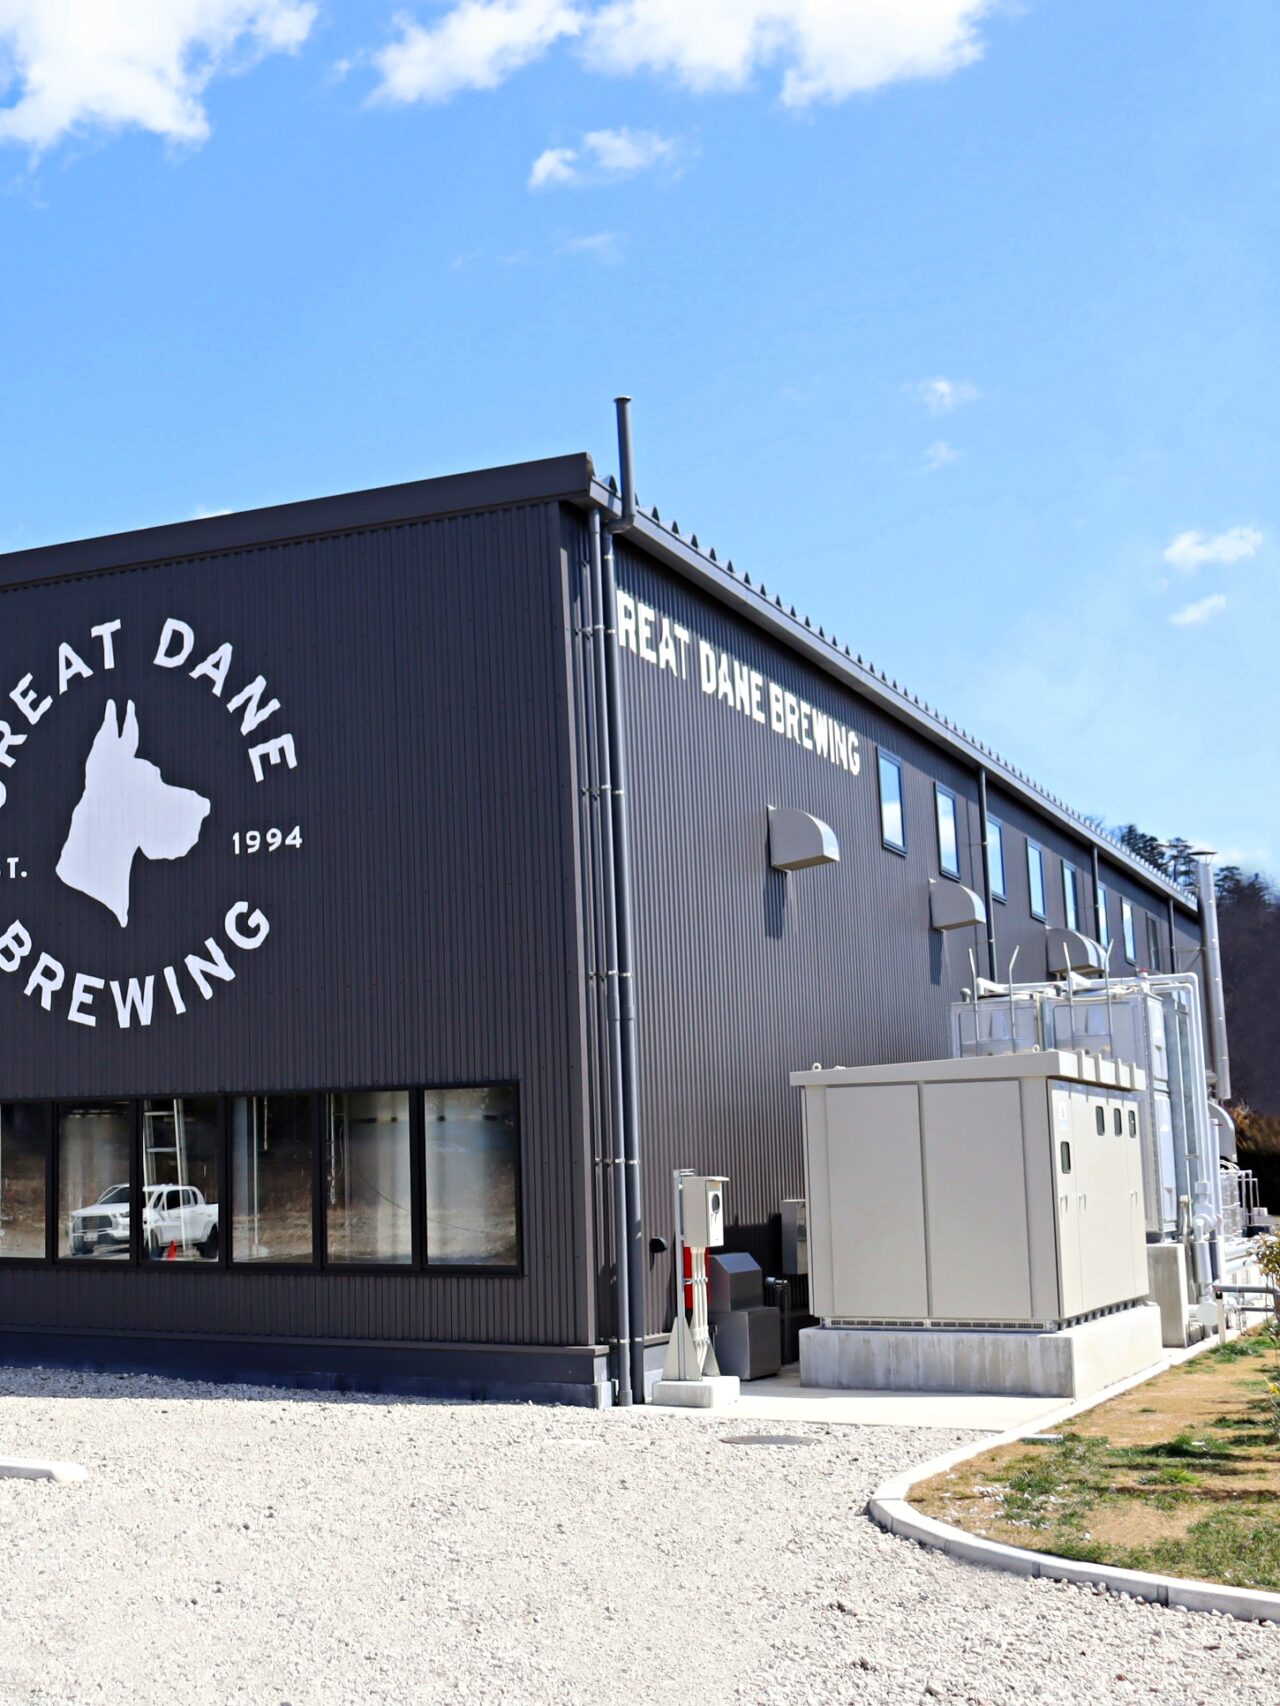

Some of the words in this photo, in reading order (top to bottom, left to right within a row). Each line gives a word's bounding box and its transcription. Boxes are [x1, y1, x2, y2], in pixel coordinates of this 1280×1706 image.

[153, 617, 298, 783] DANE
[615, 588, 690, 681] REAT
[699, 640, 766, 724] DANE
[769, 682, 861, 776] BREWING
[232, 825, 303, 855] 1994
